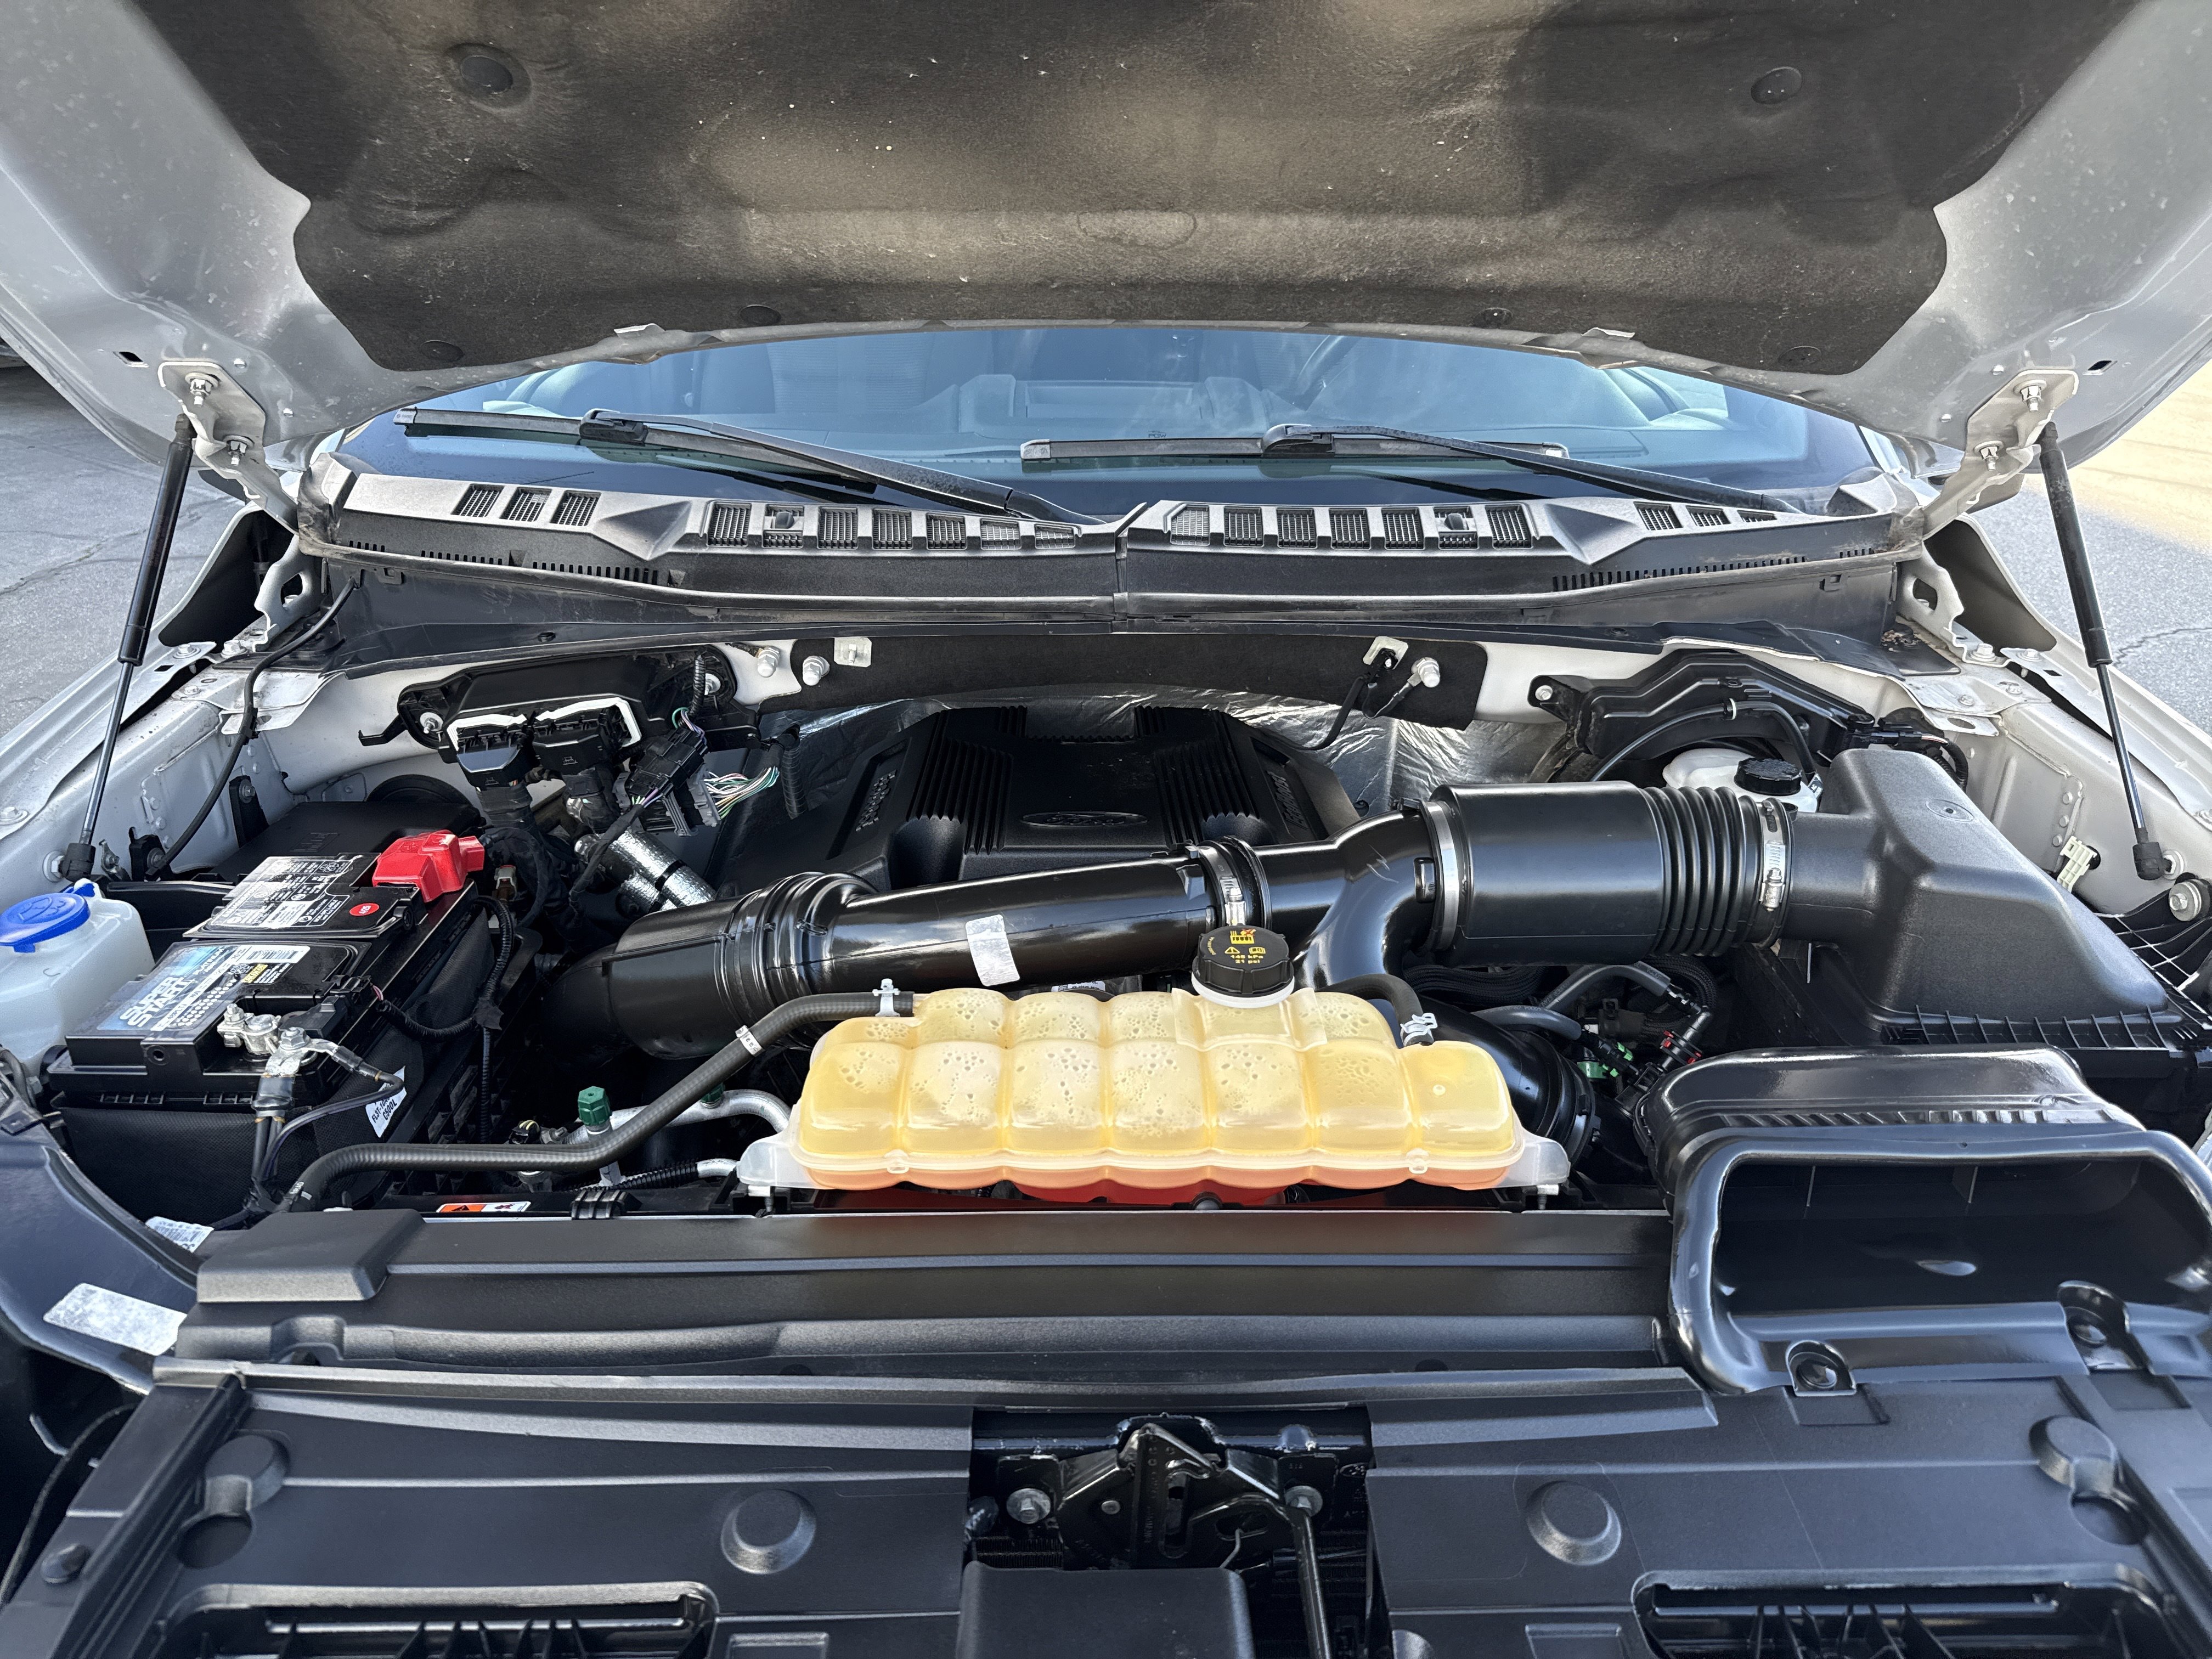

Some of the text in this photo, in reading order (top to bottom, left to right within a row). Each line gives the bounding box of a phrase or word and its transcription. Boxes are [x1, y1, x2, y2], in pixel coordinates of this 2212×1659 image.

[1265, 770, 1308, 830] EcoBoost
[192, 948, 225, 975] PLATINUM
[120, 977, 178, 1020] SUPER
[127, 978, 193, 1028] START
[382, 1098, 398, 1121] C500L
